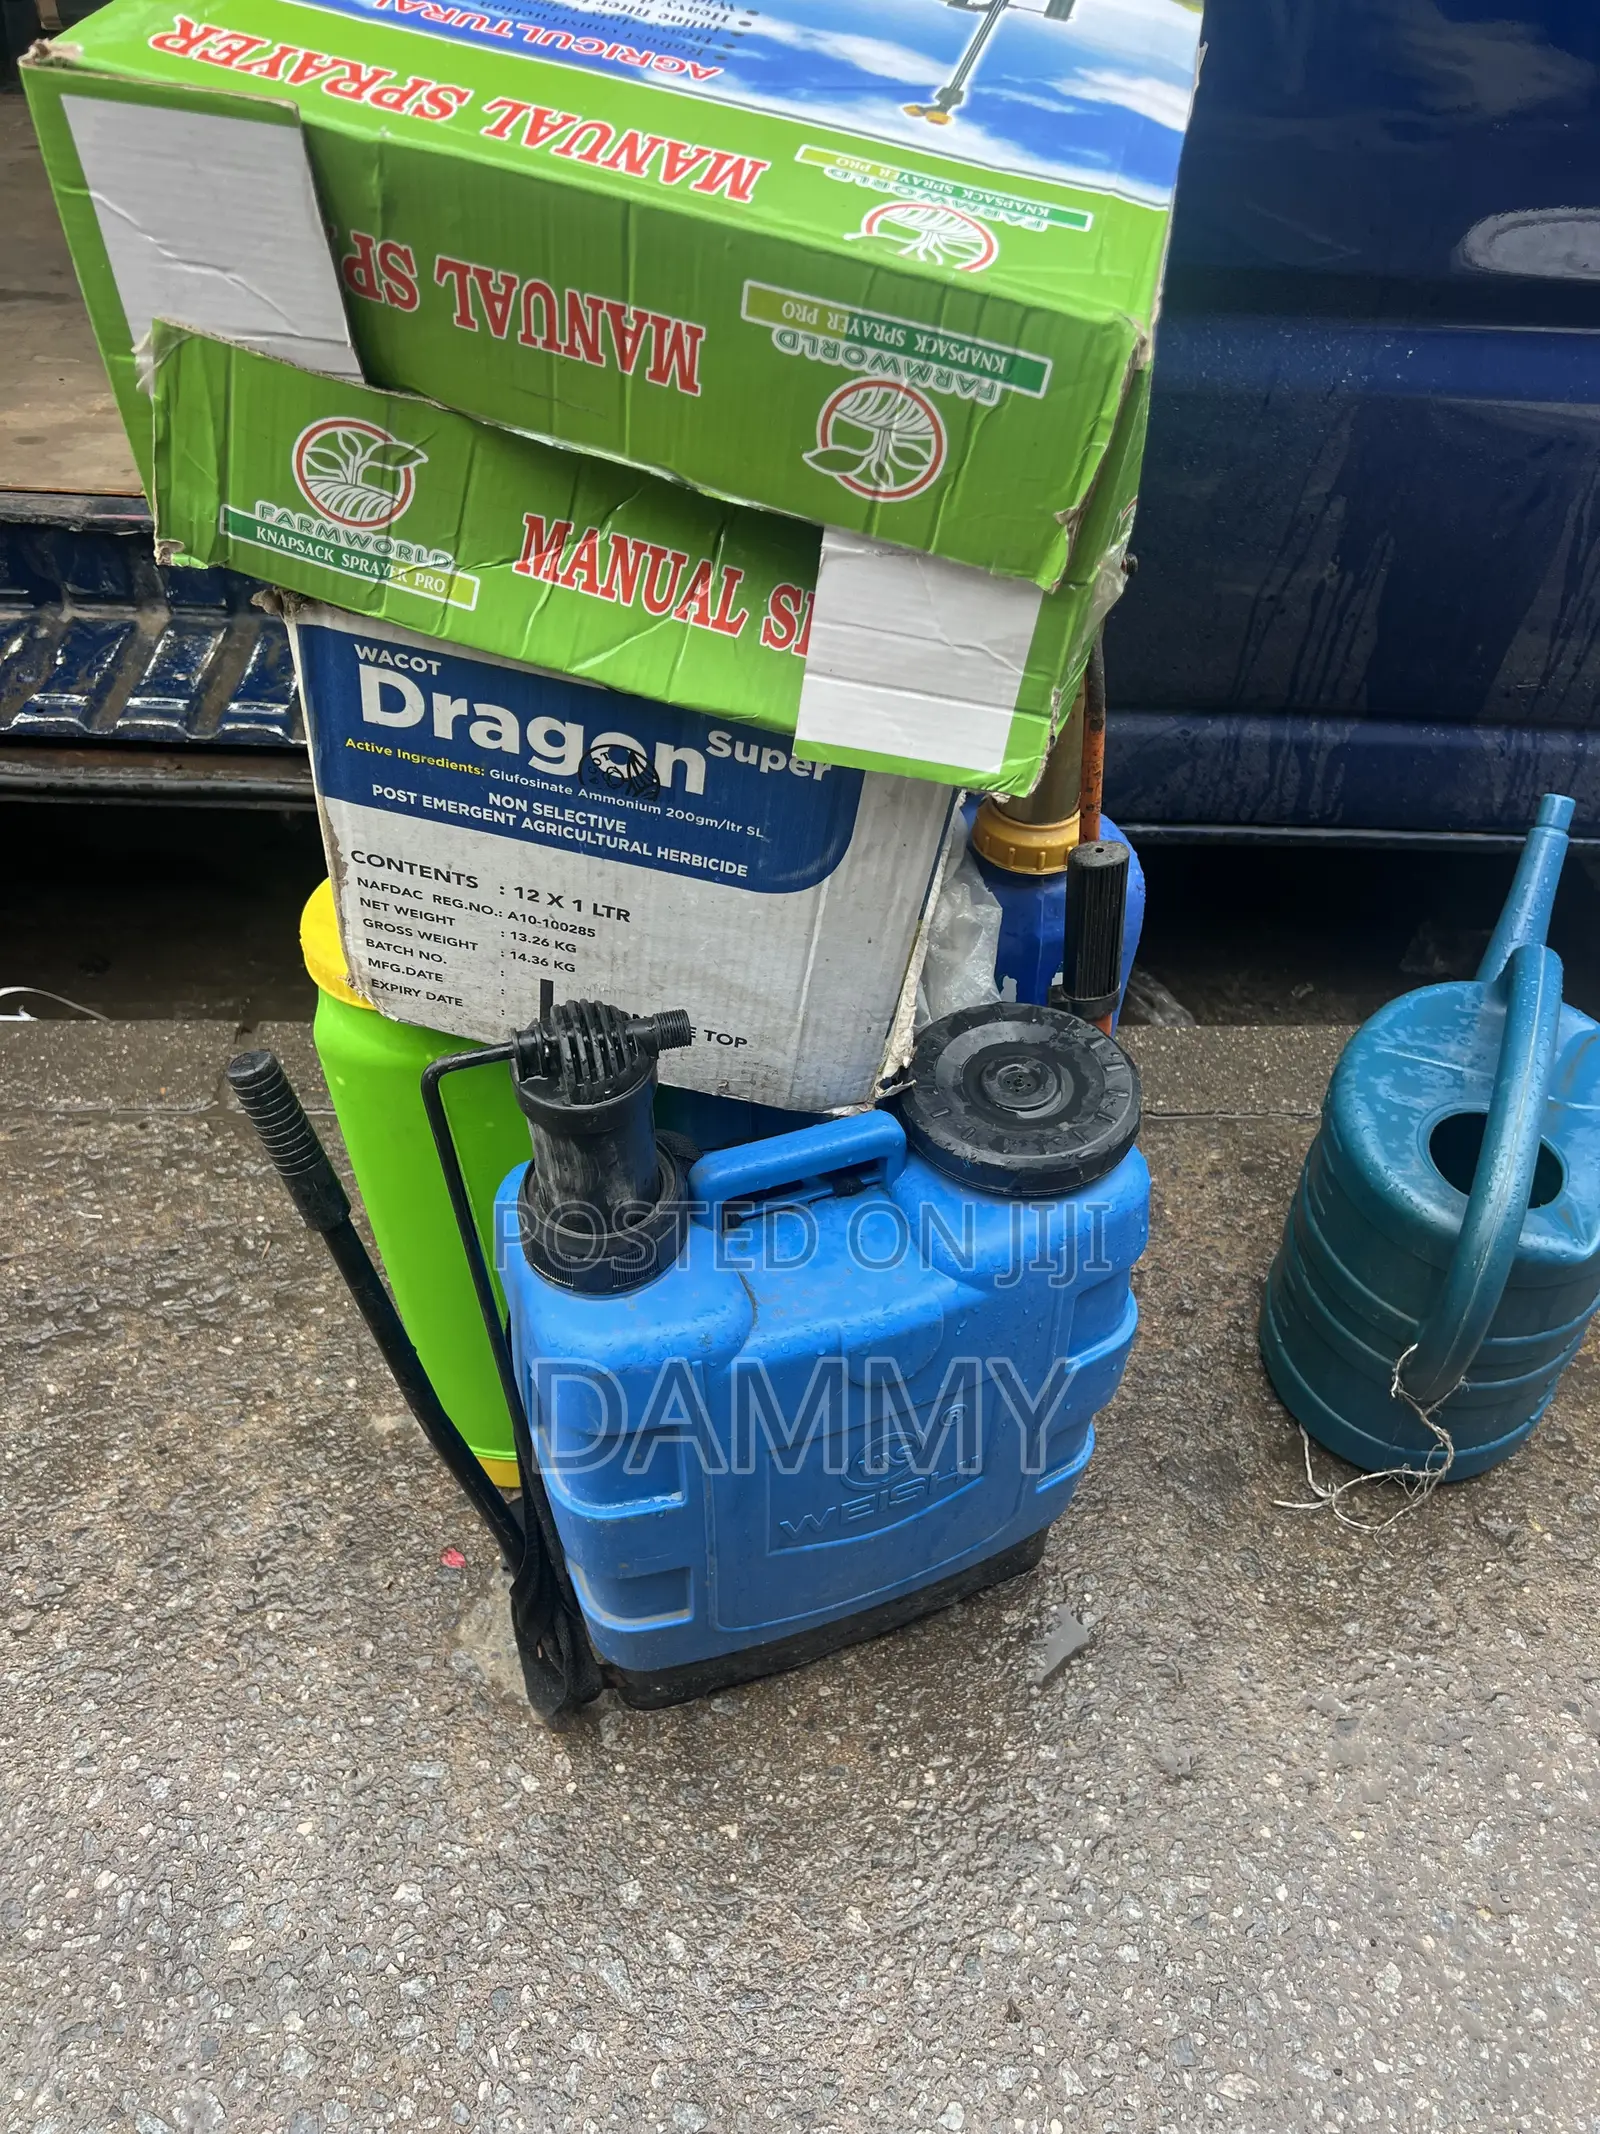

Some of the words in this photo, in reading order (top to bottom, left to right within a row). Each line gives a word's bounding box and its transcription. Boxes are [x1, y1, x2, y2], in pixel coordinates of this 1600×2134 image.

[148, 15, 473, 122] SPRAYER
[481, 96, 770, 203] MANUAL
[835, 156, 872, 174] PRO
[825, 166, 1047, 231] FARMWORLD
[876, 167, 953, 194] SPRAYER
[963, 190, 1051, 218] KNAPSACK
[434, 254, 706, 396] MANUAL
[781, 299, 819, 325] PRO
[827, 311, 906, 347] SPRAYER
[772, 328, 1001, 406] FARMWORLD
[913, 333, 1007, 376] KNAPSACK
[256, 525, 335, 563] KNAPSACK
[342, 553, 407, 583] SPRAYER
[414, 571, 446, 593] PRO
[257, 501, 455, 570] FARMWORLD
[512, 513, 749, 638] MANUAL
[353, 643, 441, 676] WACOT
[358, 663, 707, 795] Dragon
[706, 729, 832, 781] Super
[345, 738, 392, 757] Active
[397, 748, 485, 776] Ingredients:
[489, 769, 573, 795] Glufosinate
[578, 788, 661, 815] Ammonium
[666, 807, 742, 832] 200gm/ltr
[746, 826, 764, 838] SL
[488, 792, 527, 812] NON
[533, 803, 627, 834] SELECTIVE
[372, 784, 417, 804] POST
[422, 794, 516, 826] EMERGENT
[521, 817, 652, 856] AGRICULTURAL
[657, 846, 748, 877] HERBICIDE
[351, 849, 479, 889] CONTENTS
[514, 886, 540, 902] 12
[547, 892, 564, 908] X
[572, 899, 582, 912] 1
[592, 902, 631, 923] LTR
[357, 876, 423, 900] NAFDAC
[508, 911, 596, 938] A10-100285
[360, 896, 389, 912] NET
[394, 904, 455, 926] WEIGHT
[510, 930, 549, 947] 13.26
[555, 940, 577, 953] KG
[363, 918, 413, 937] GROSS
[418, 930, 478, 951] WEIGHT
[510, 950, 549, 967] 14.36
[554, 960, 576, 973] KG
[366, 938, 414, 957] BATCH
[418, 949, 447, 965] NO.
[368, 957, 443, 982] MFG.DATE
[371, 978, 421, 998] EXPIRY
[426, 991, 463, 1007] DATE
[704, 1029, 748, 1048] TOP
[780, 1455, 980, 1539] WEISHI
